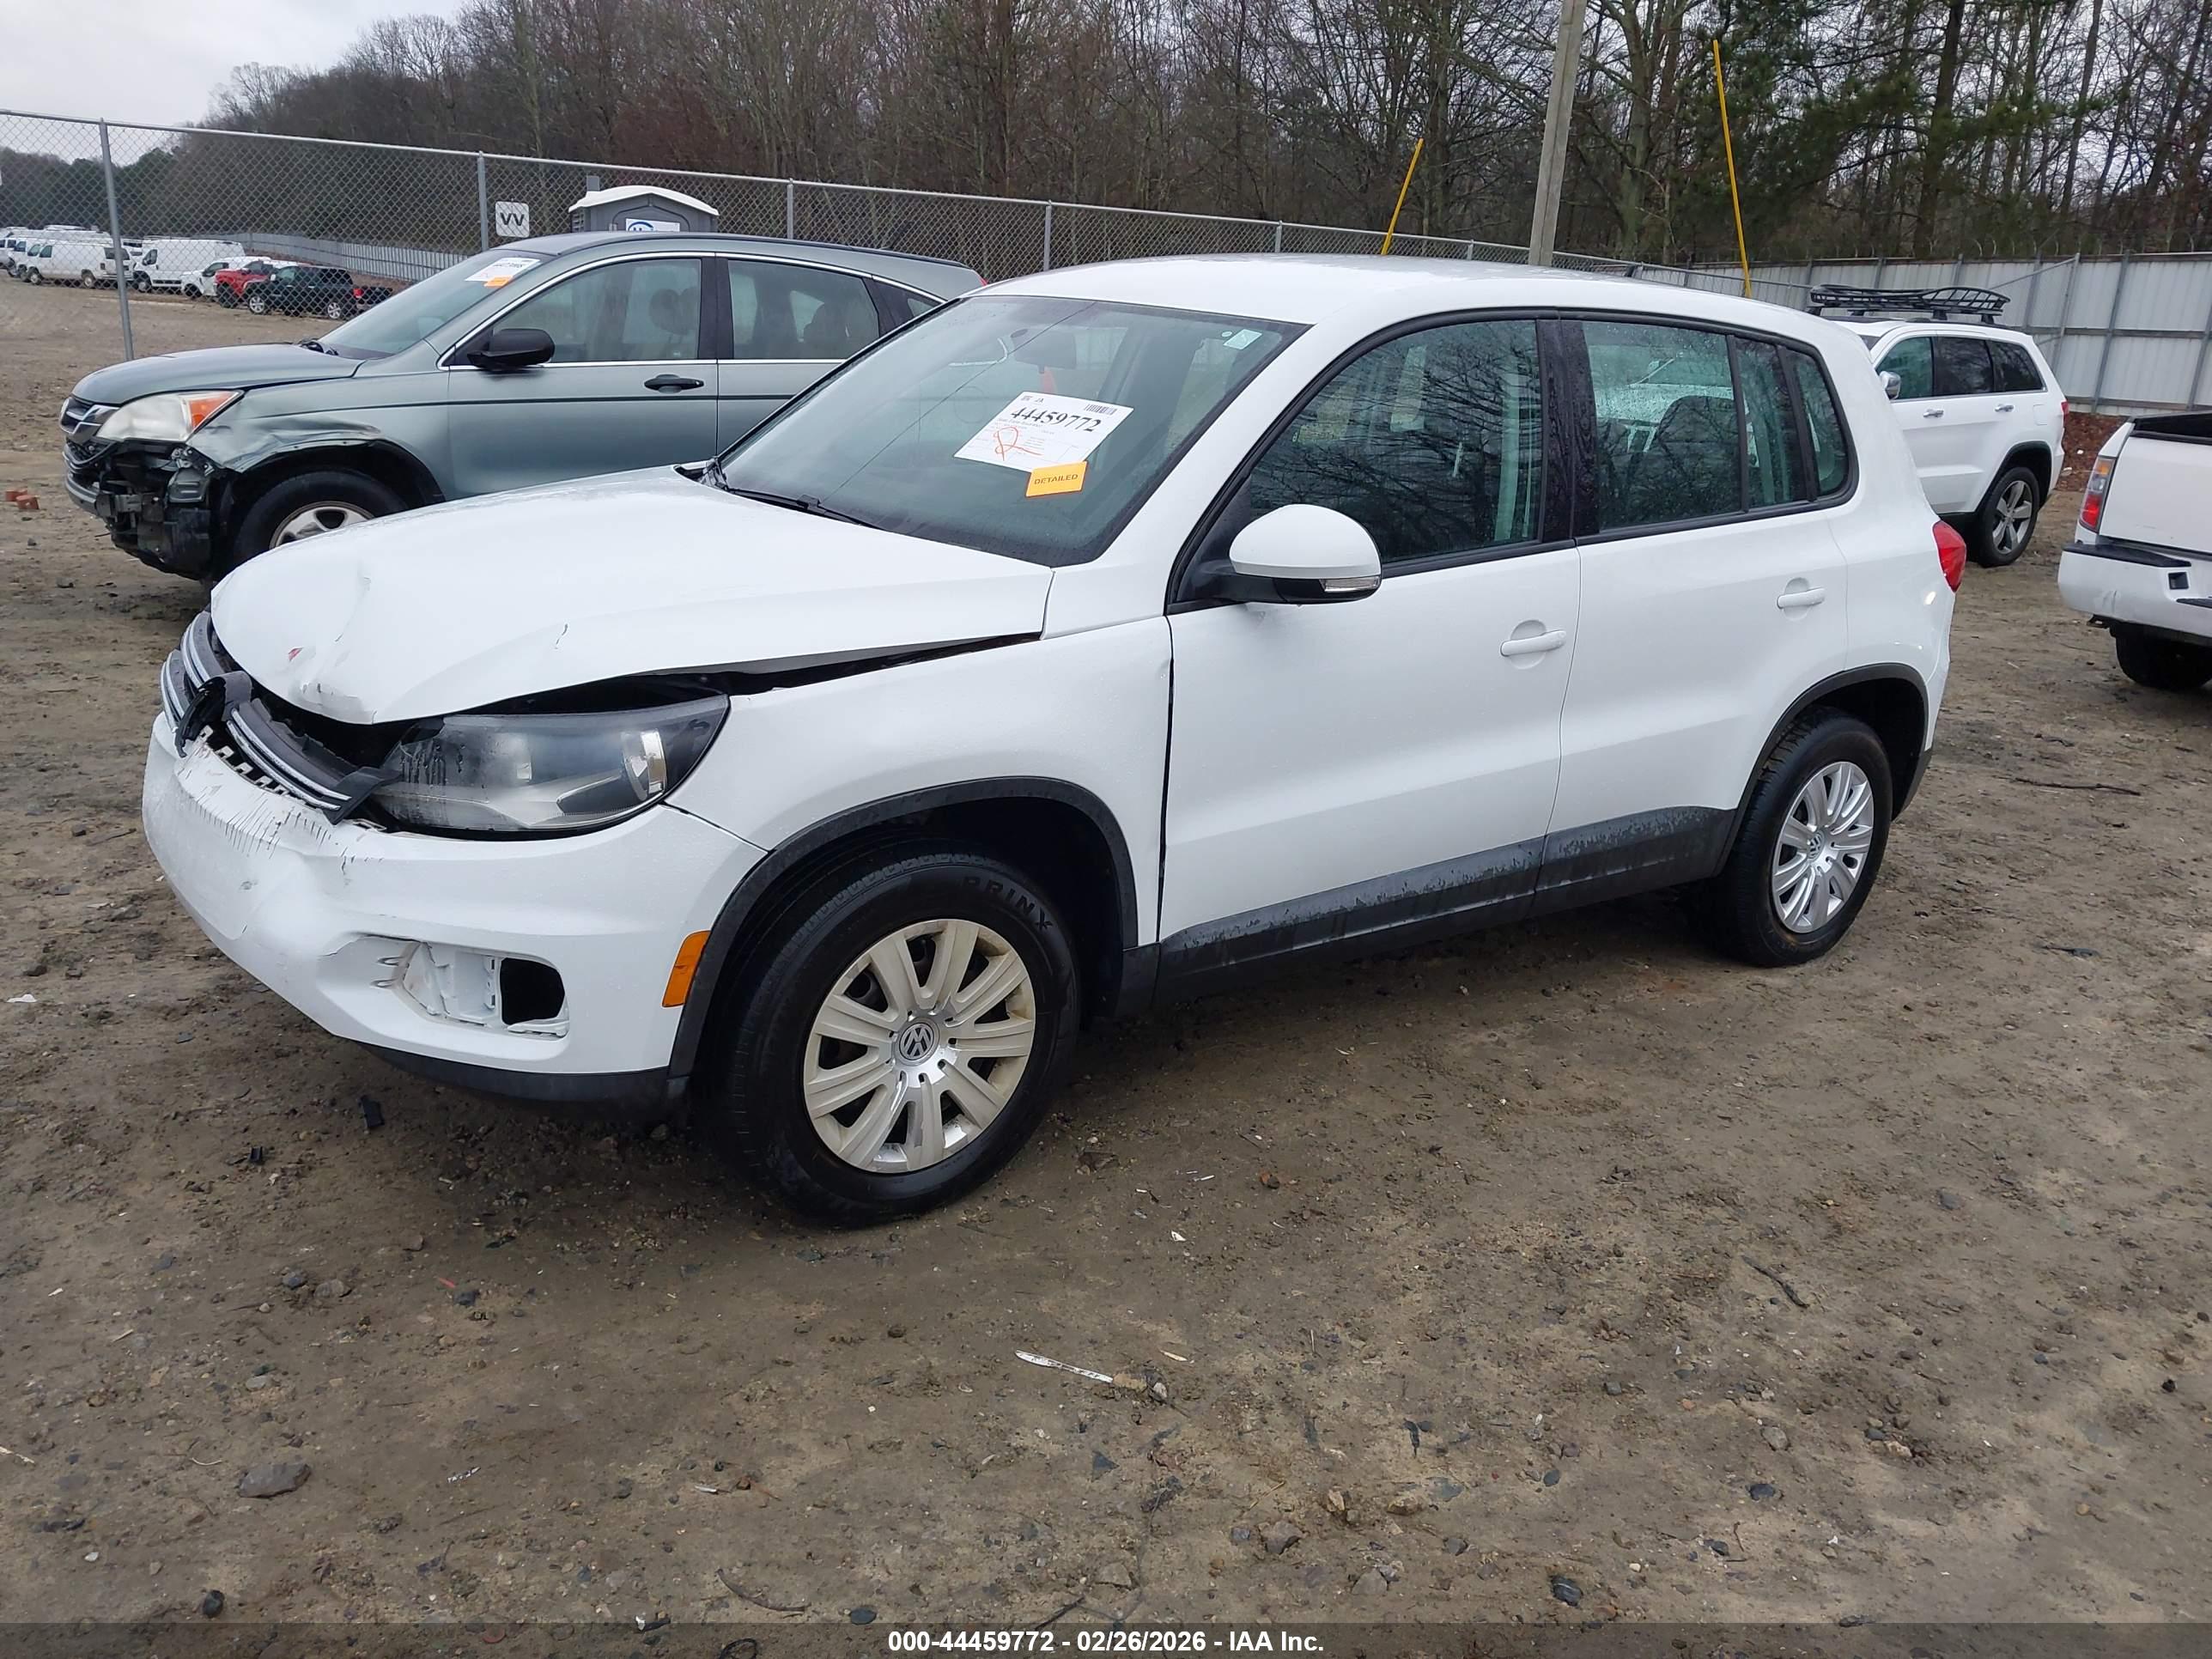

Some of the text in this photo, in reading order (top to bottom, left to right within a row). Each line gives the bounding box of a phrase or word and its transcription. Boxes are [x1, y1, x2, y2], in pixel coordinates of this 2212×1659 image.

[1011, 407, 1102, 432] 44459772
[1034, 473, 1079, 485] DETAILED
[962, 876, 1054, 930] PRINX
